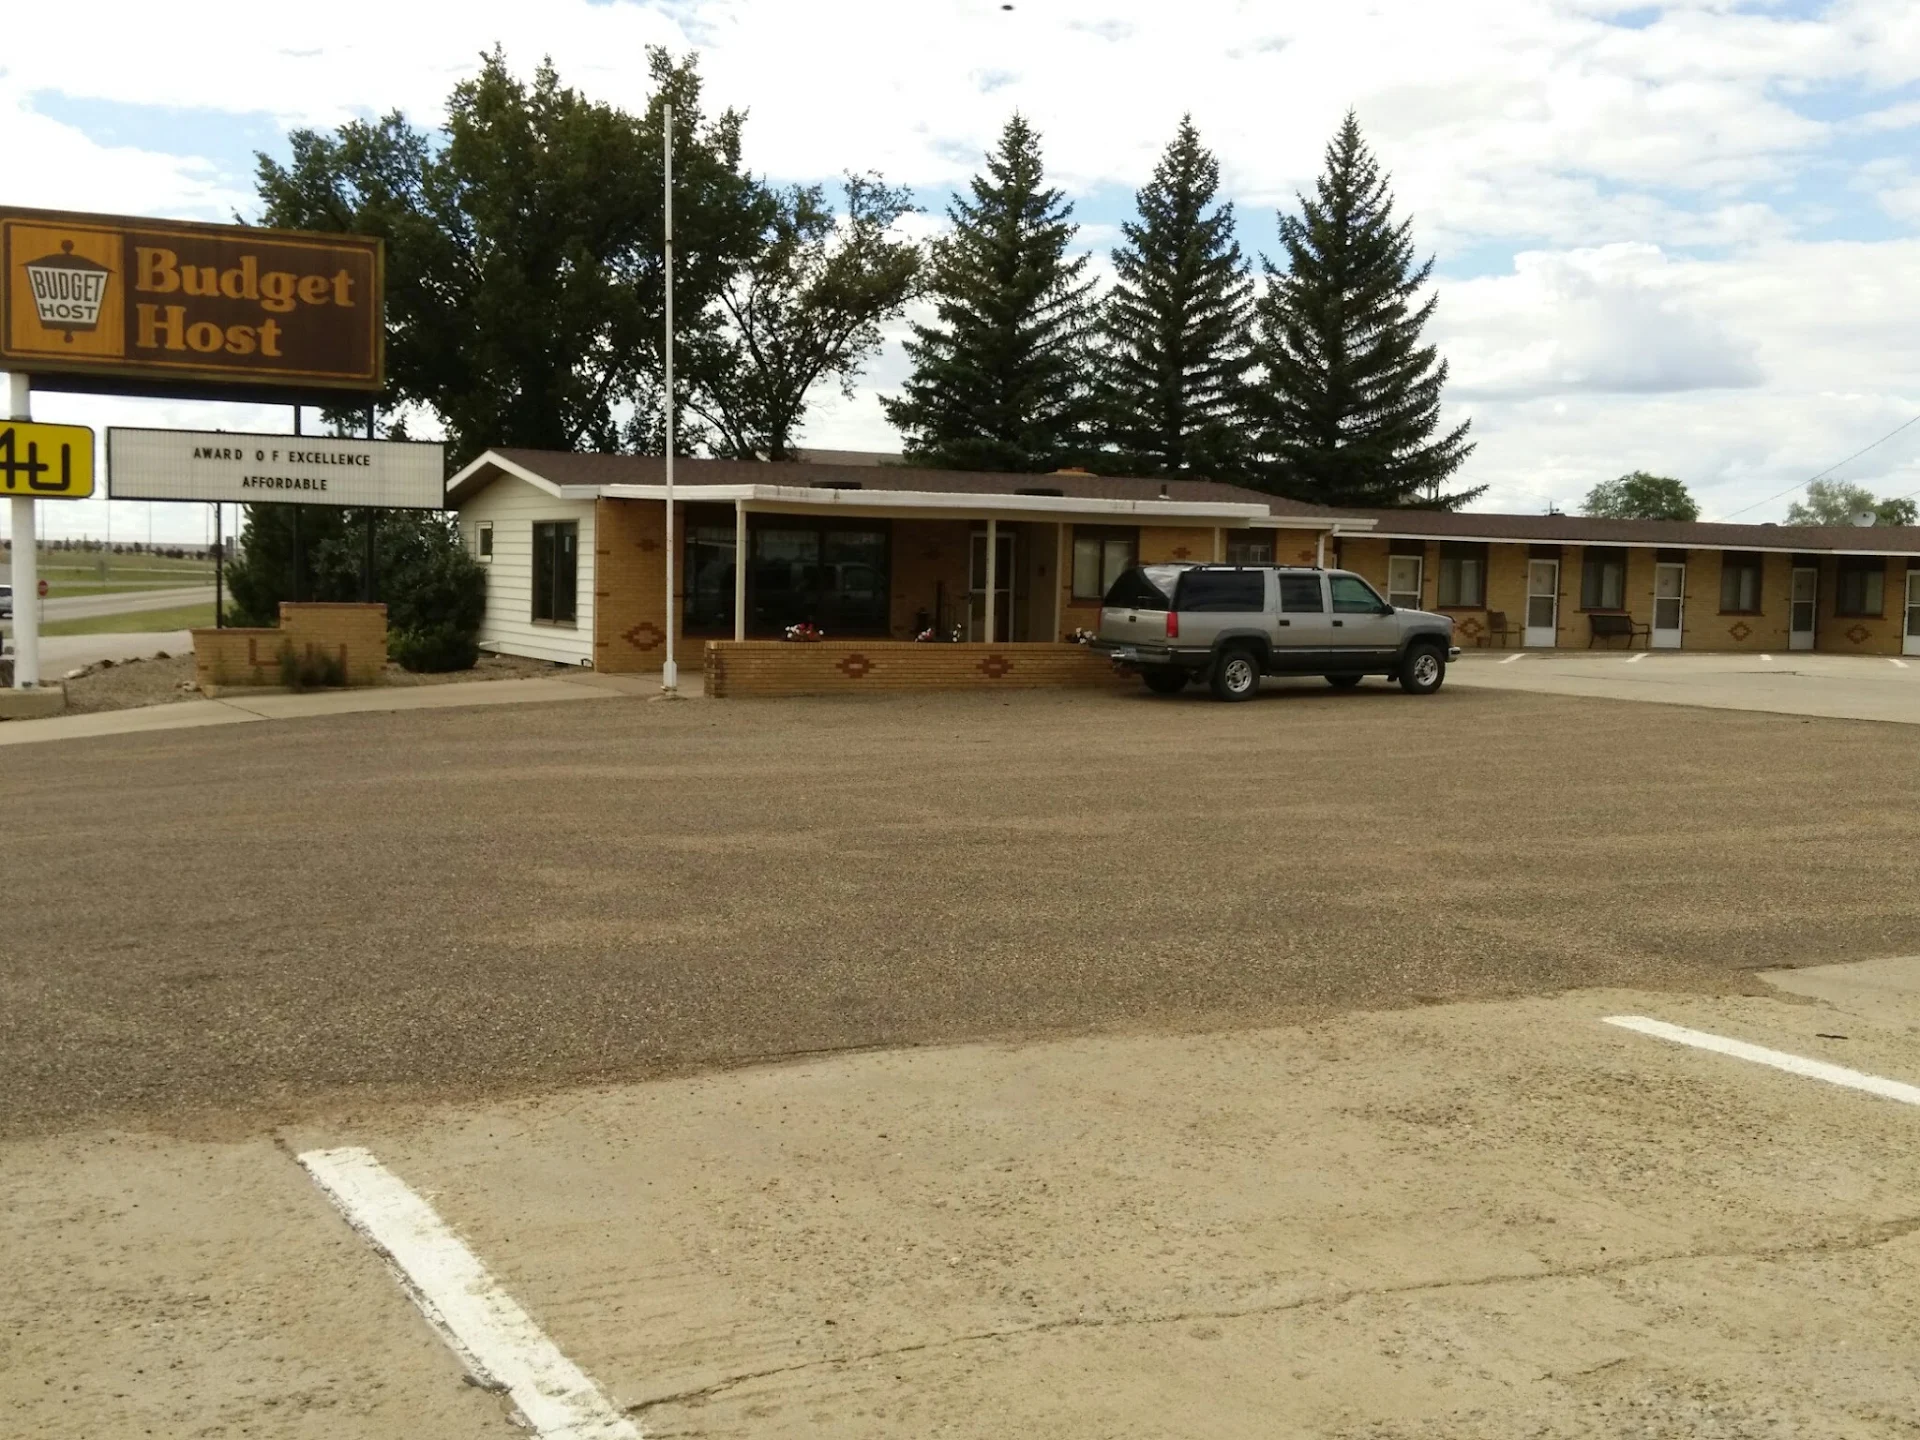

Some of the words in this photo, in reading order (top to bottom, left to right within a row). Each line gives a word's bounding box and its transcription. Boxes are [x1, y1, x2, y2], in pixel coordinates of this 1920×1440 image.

[32, 270, 104, 302] BUDGET
[135, 246, 355, 312] Budget
[40, 303, 97, 320] HOST
[136, 303, 282, 357] Host
[193, 447, 243, 461] AWARD
[289, 451, 371, 466] EXCELLENCE
[242, 476, 328, 491] AFFORDABLE
